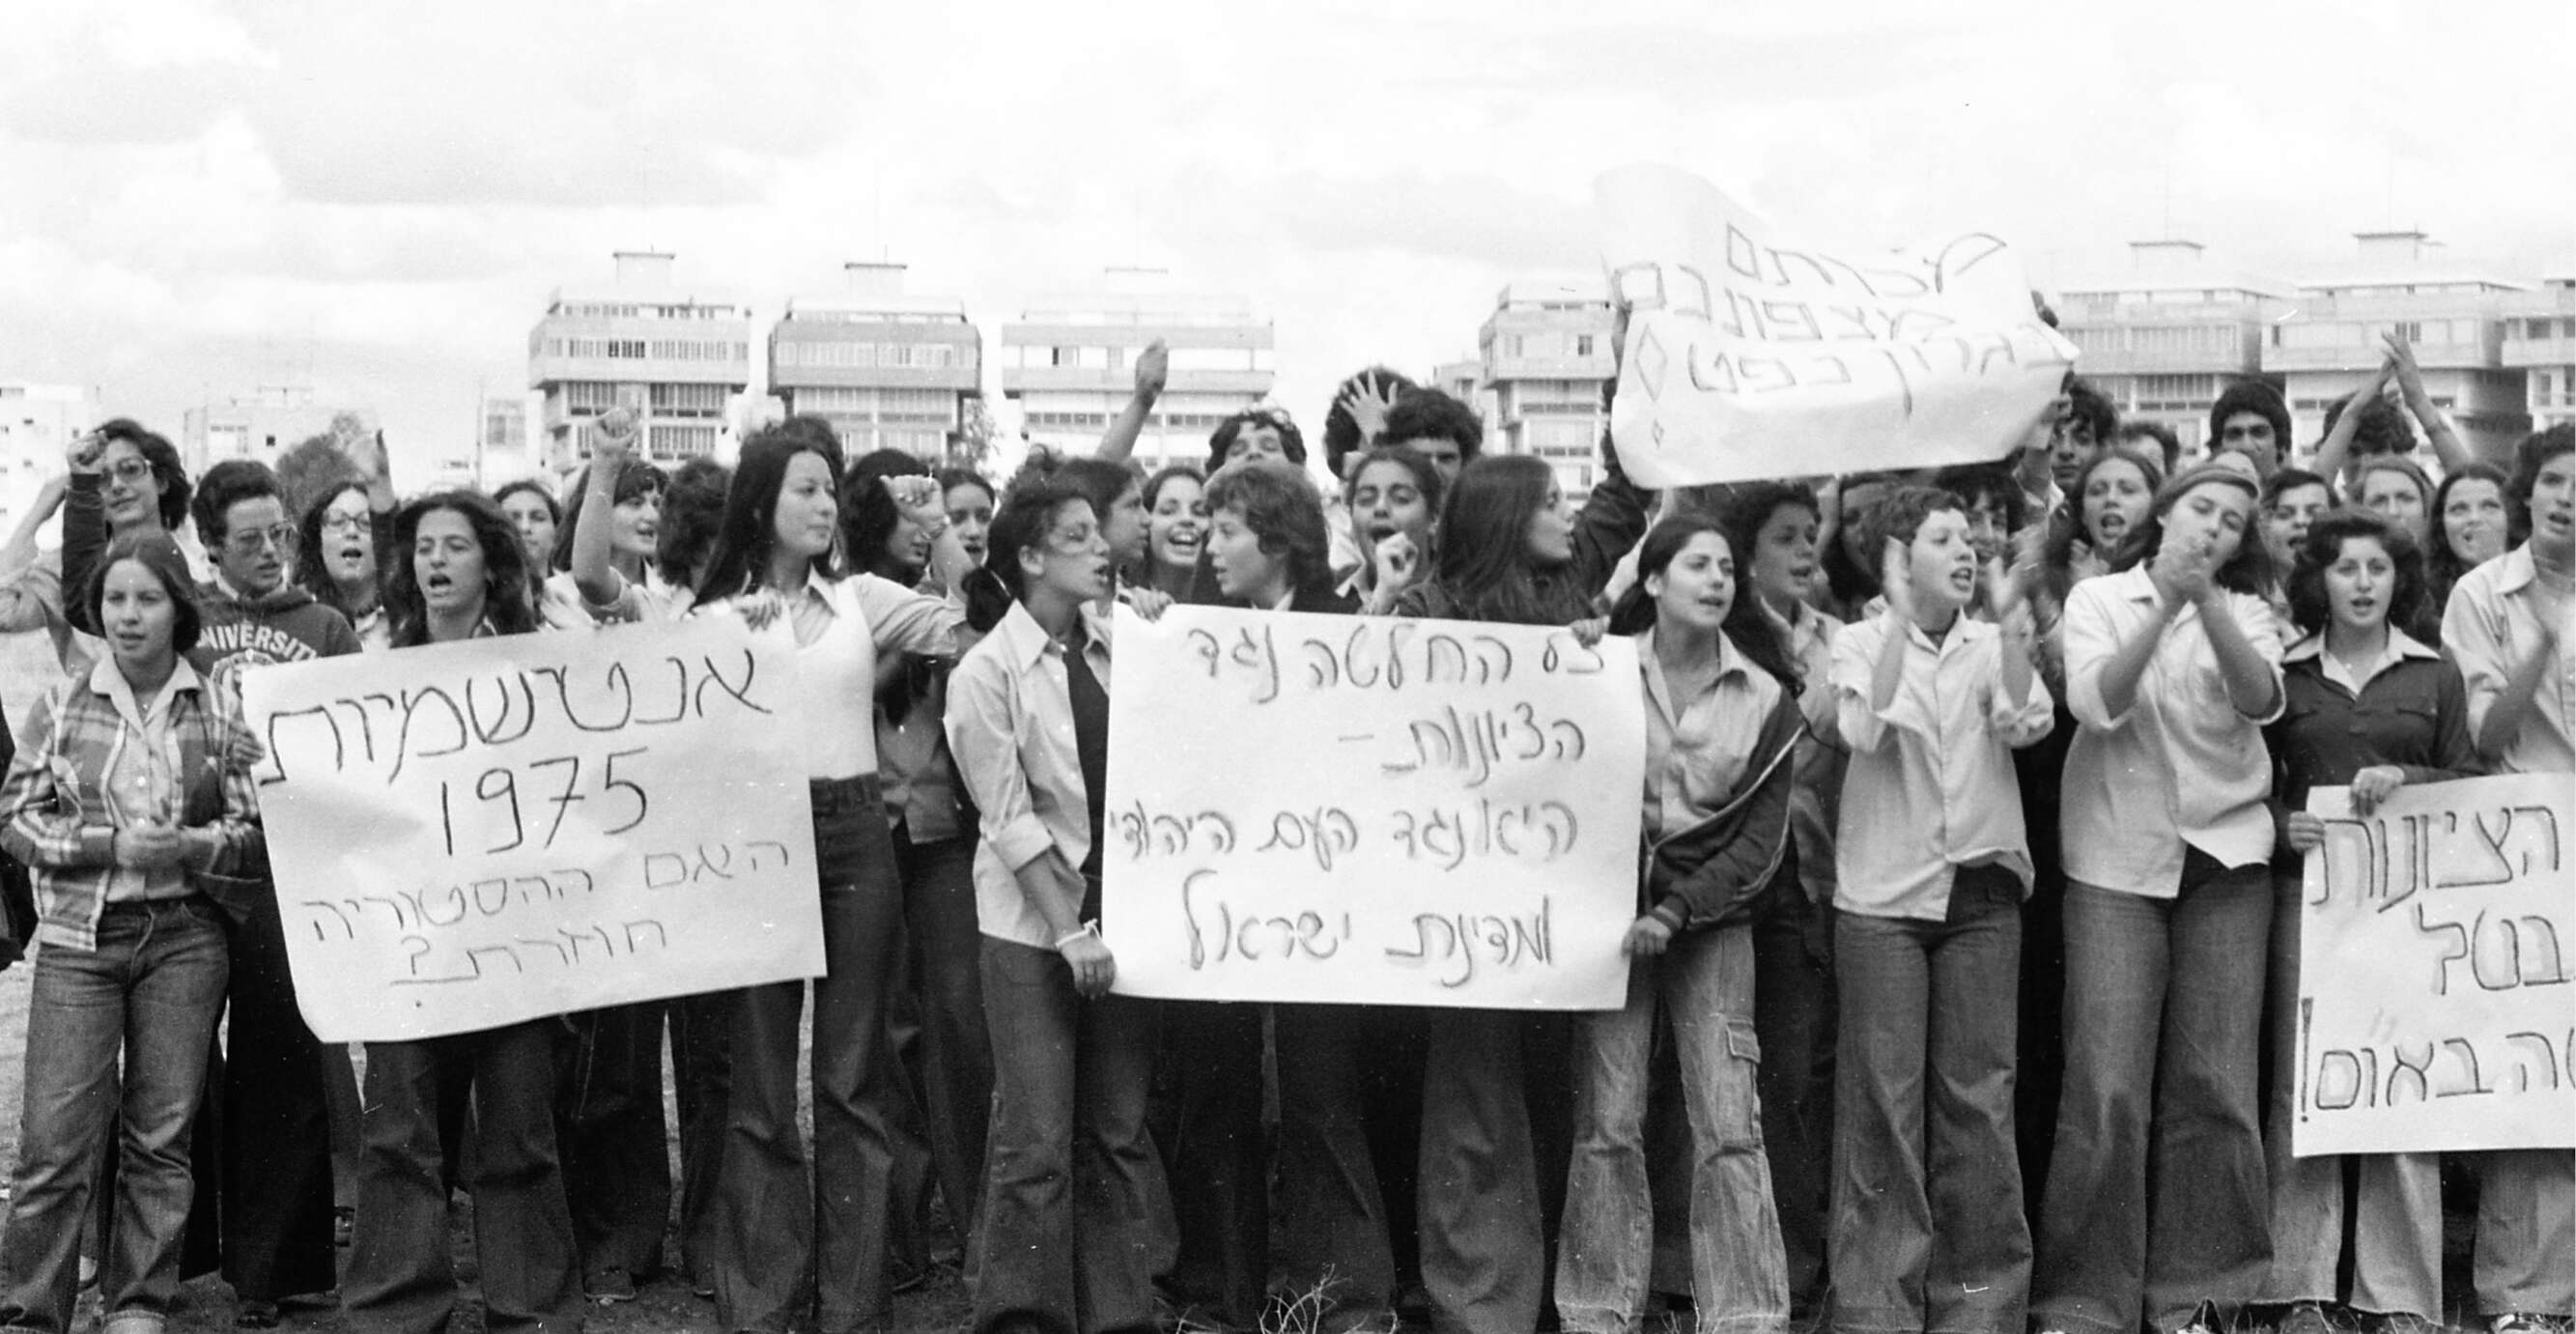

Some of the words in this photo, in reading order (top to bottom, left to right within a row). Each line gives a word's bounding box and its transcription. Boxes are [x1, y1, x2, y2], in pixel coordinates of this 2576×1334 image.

[195, 621, 319, 662] NIVERSIT
[1187, 622, 1279, 704] נגד
[259, 647, 773, 787] אנטישמיות
[1381, 701, 1585, 788] הציונות
[437, 746, 649, 857] 1975
[1109, 798, 1236, 862] היהודי
[1256, 805, 1359, 873] העם
[1392, 806, 1466, 872] נגד
[1481, 797, 1578, 862] היא
[644, 840, 789, 891] האם
[2308, 804, 2562, 915] הציונות
[300, 867, 594, 944] ההסטוריה
[1181, 867, 1351, 971] ישראל
[2416, 902, 2571, 997] בטל
[2505, 1026, 2576, 1093] ה
